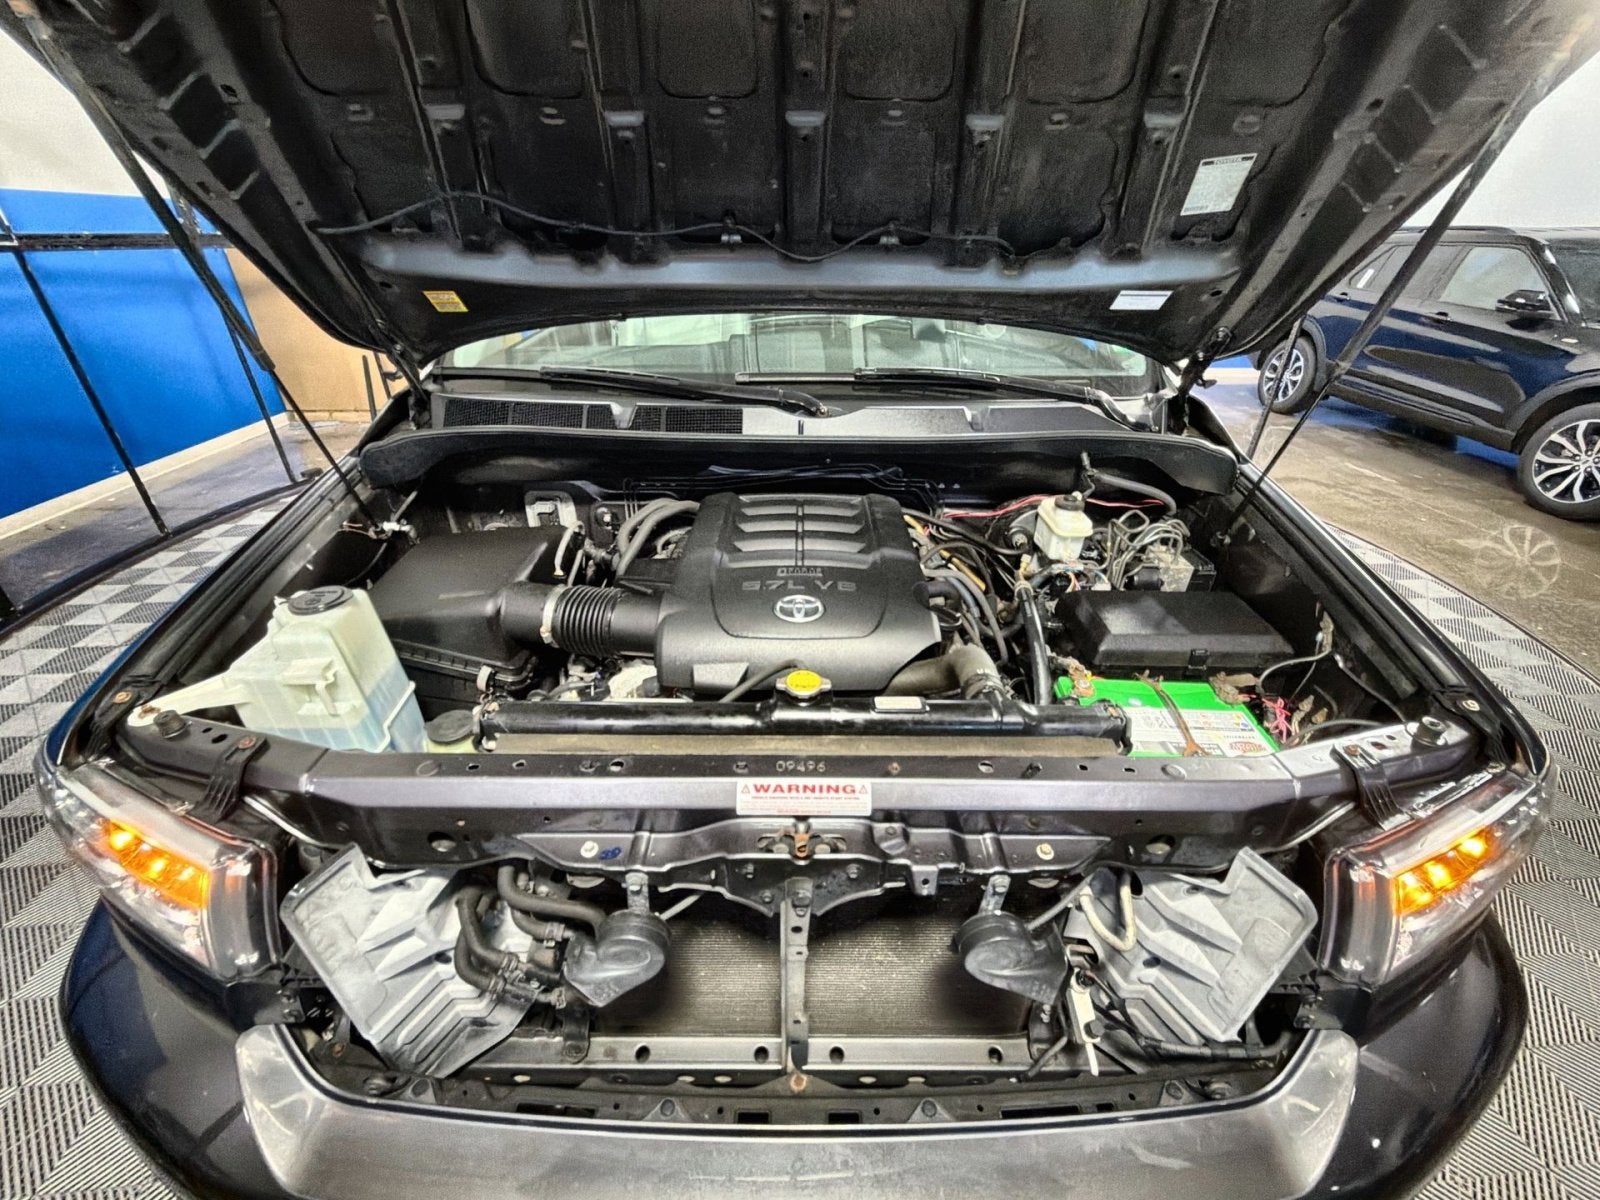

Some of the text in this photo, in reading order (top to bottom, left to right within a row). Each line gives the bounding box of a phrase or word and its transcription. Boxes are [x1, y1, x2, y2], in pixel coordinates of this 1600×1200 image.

[742, 580, 857, 592] 5.7L V8
[775, 760, 826, 773] 09496
[753, 783, 857, 795] WARNING
